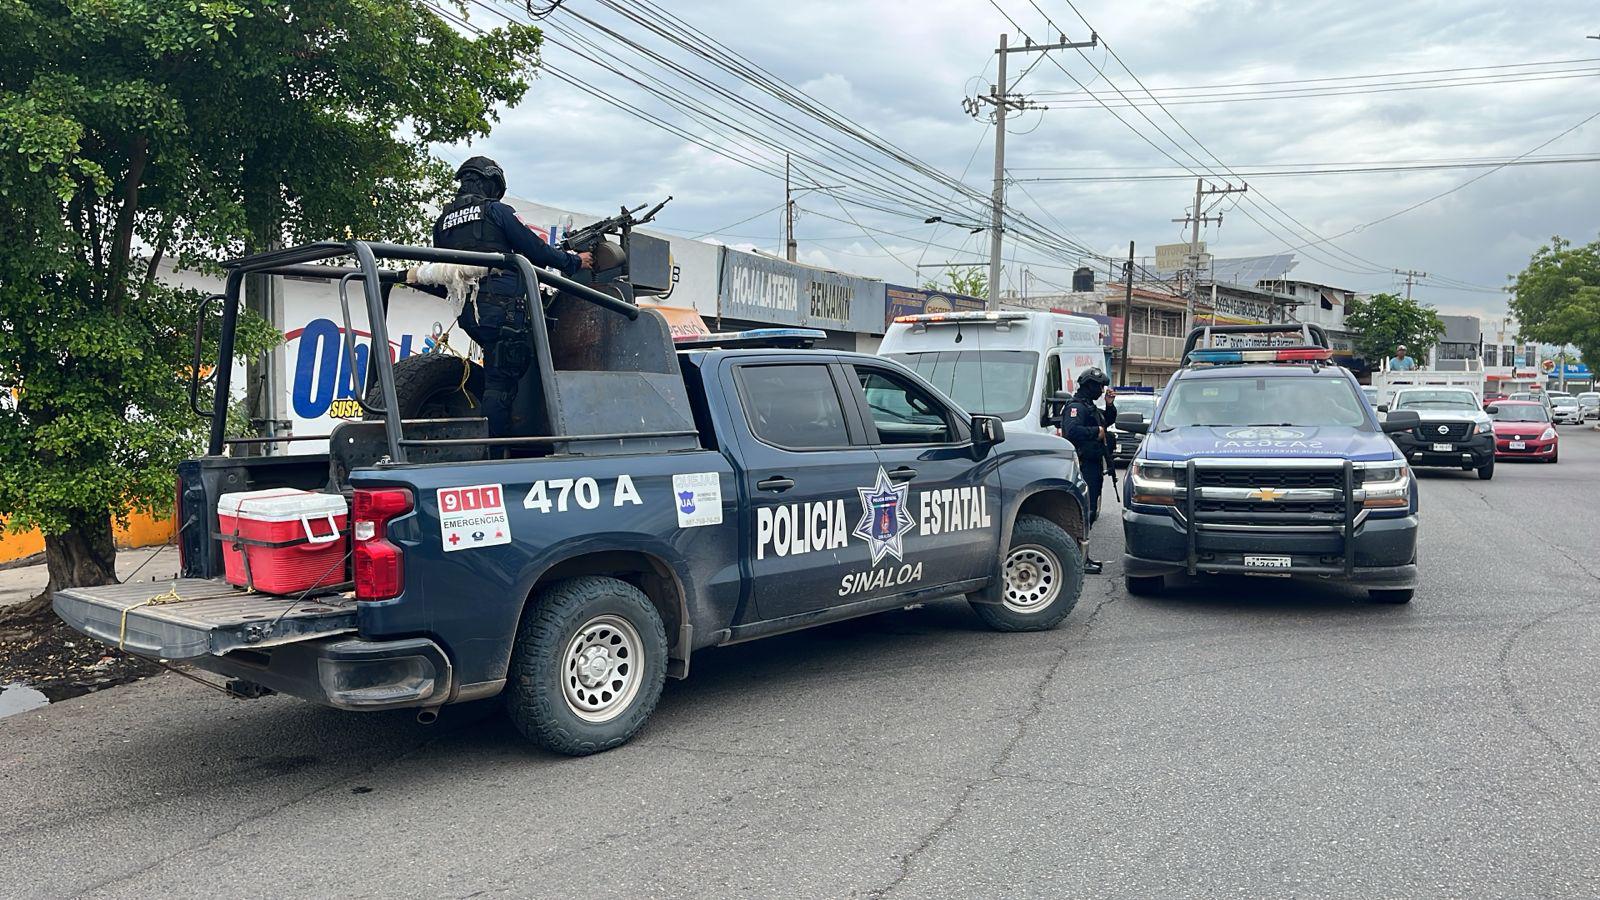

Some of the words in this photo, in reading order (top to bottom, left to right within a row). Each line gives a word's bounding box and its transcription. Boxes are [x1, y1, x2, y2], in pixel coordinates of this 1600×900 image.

[442, 213, 481, 230] ESTATAL
[732, 265, 798, 312] HOJALATERIA
[445, 490, 495, 510] 911
[523, 477, 600, 513] 470
[613, 474, 643, 507] A
[920, 485, 992, 536] ESTATAL
[443, 515, 505, 529] EMERGENCIAS
[757, 499, 848, 560] POLICIA
[838, 561, 923, 597] SINALOA
